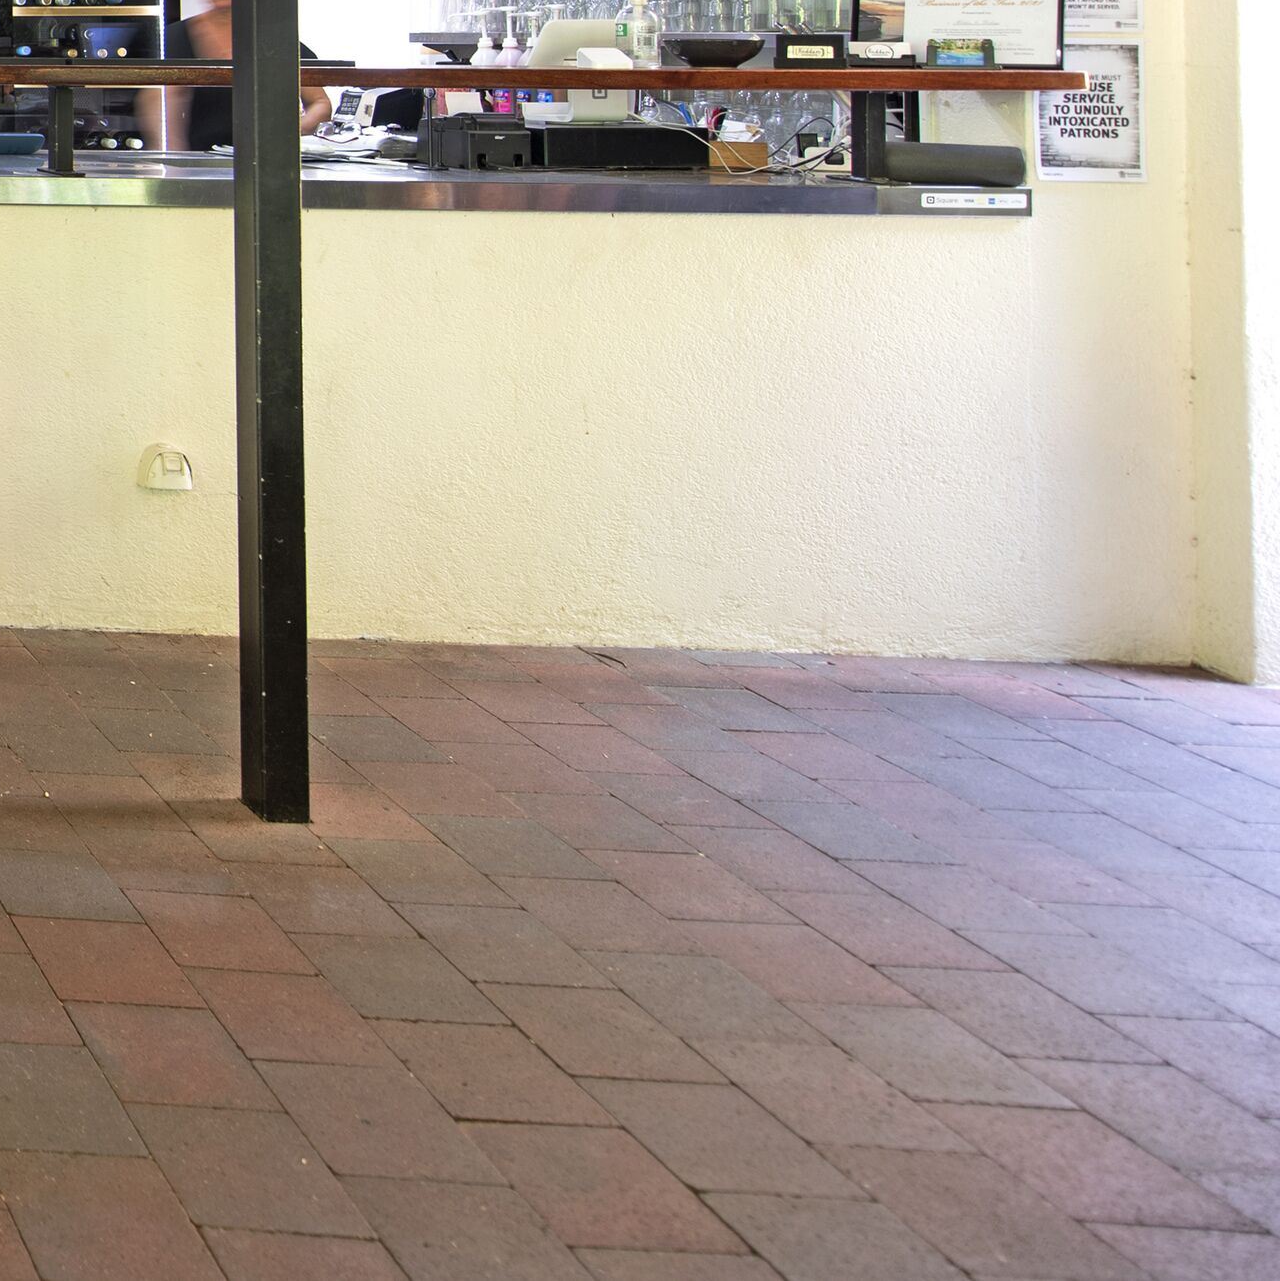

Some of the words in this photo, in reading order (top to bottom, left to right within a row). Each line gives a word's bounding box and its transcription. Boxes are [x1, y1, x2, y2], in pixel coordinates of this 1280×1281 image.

[1089, 82, 1113, 92] USE
[1063, 93, 1115, 104] SERVICE
[1053, 105, 1070, 115] TO
[1074, 105, 1124, 115] UNDULY
[1049, 116, 1129, 127] INTOXICATED
[1060, 128, 1119, 139] PATRONS
